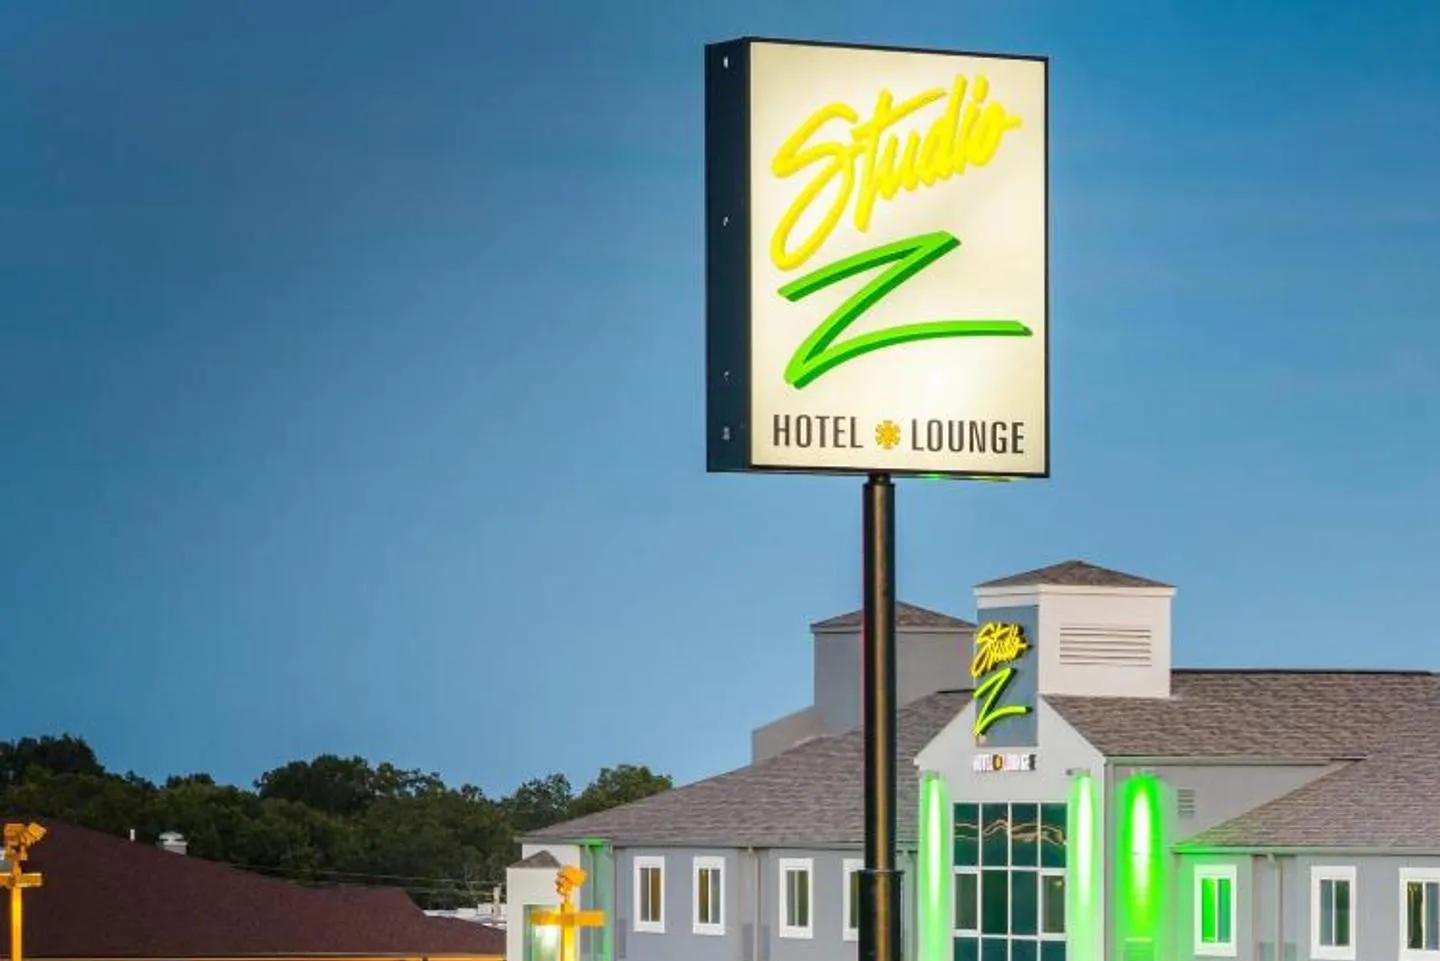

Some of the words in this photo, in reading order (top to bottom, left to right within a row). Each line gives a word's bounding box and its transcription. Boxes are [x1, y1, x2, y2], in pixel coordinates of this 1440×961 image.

[770, 73, 1022, 272] Studio
[777, 230, 1033, 389] Z
[773, 413, 864, 449] HOTEL
[911, 418, 1025, 455] LOUNGE
